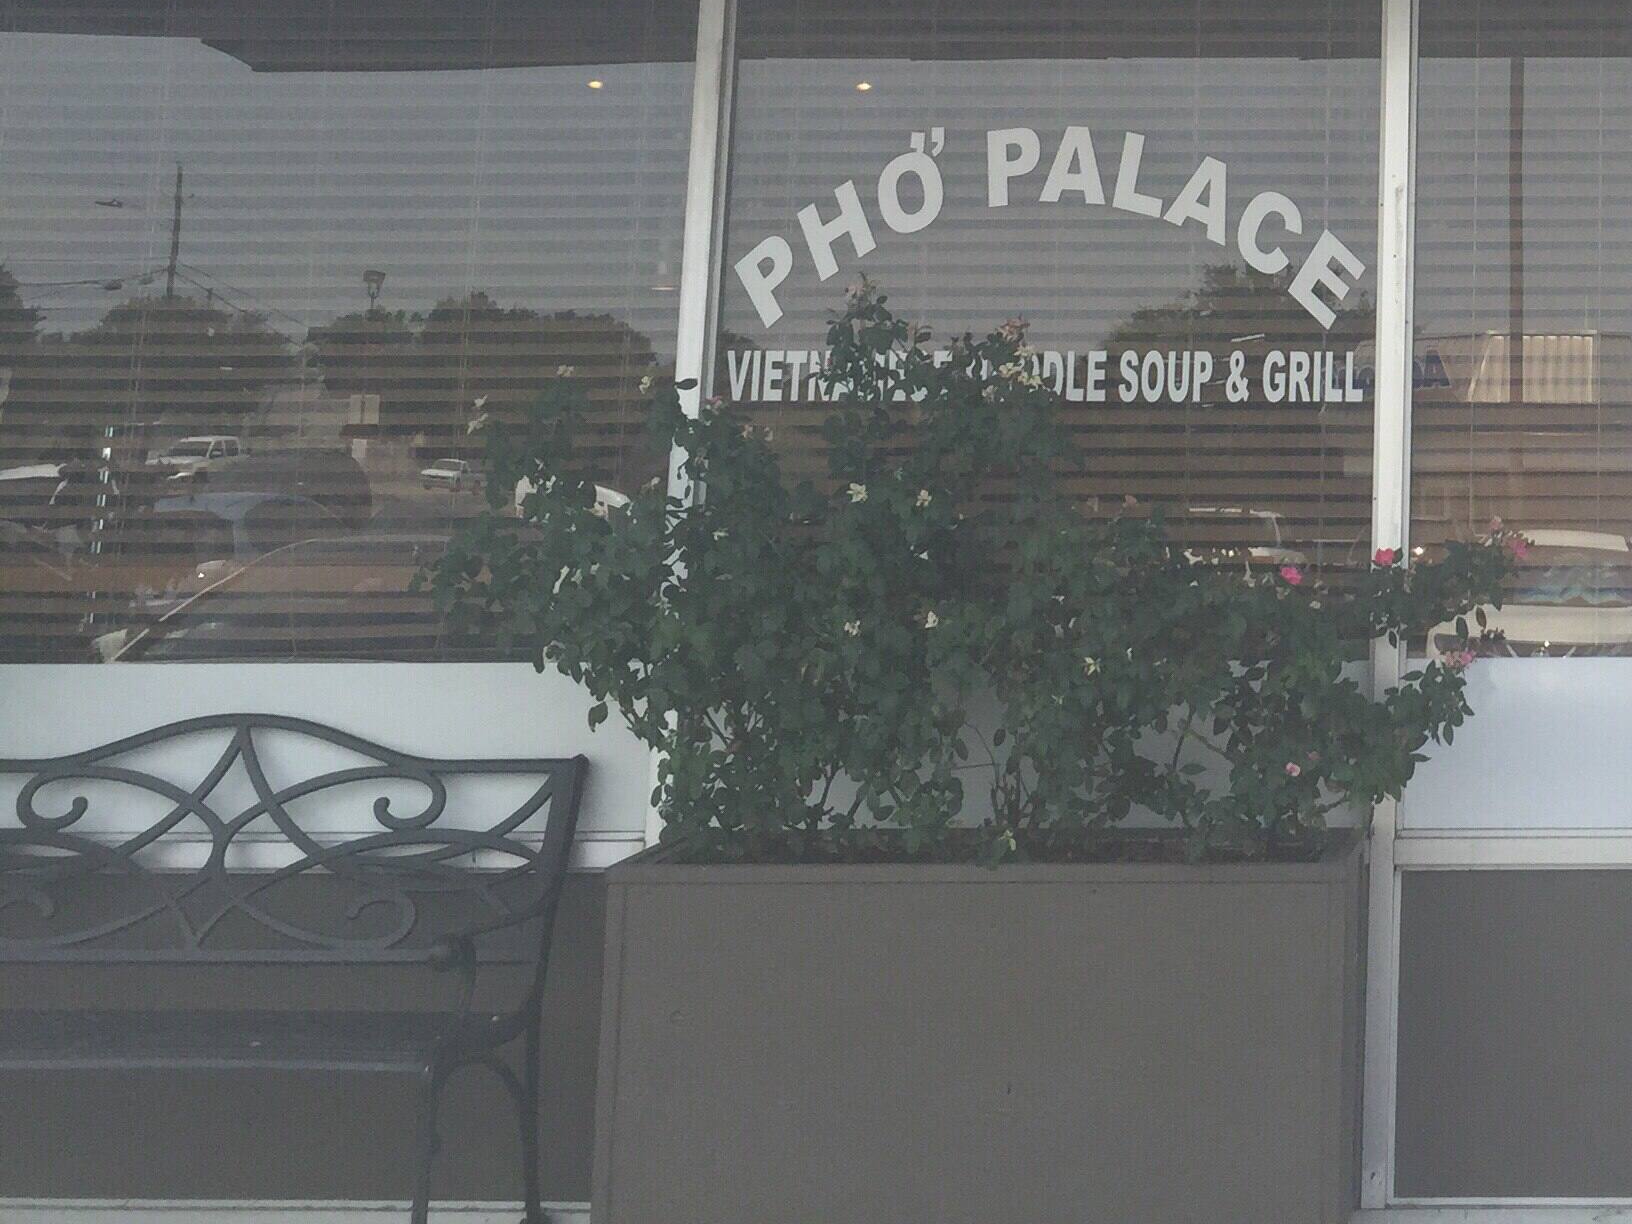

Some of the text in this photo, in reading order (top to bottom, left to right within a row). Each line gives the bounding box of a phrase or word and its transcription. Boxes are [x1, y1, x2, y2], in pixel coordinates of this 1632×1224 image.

[987, 126, 1366, 329] PALACE
[1119, 349, 1210, 404] SOUP
[1225, 350, 1250, 403] &
[1262, 349, 1364, 403] GRILL
